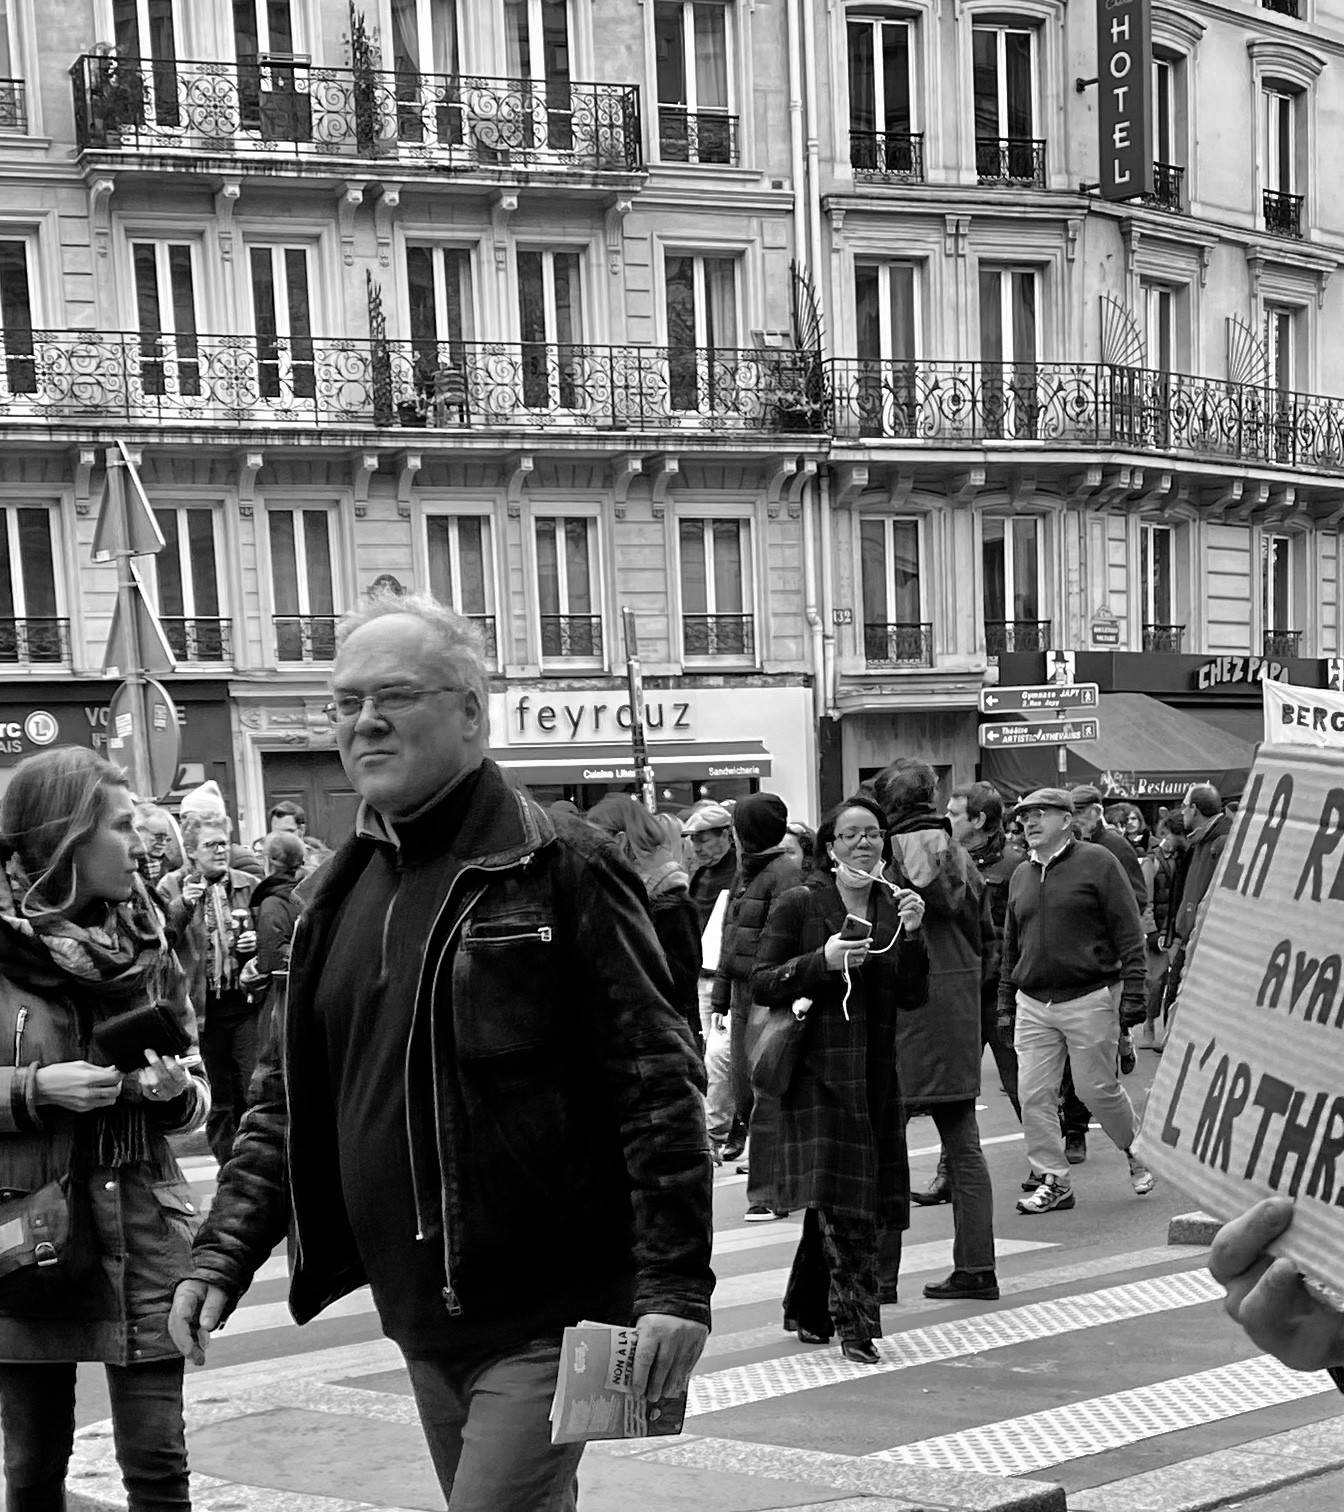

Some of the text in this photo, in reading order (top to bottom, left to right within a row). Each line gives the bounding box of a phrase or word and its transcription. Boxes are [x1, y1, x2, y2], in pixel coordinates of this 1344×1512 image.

[1109, 14, 1132, 185] HOTEL
[833, 610, 852, 622] 132
[1198, 657, 1289, 690] CHEZ PAPA
[1059, 689, 1080, 698] JAPY
[516, 695, 691, 739] feyrouz
[1219, 773, 1294, 898] LA
[618, 1331, 628, 1346] LA
[612, 1359, 625, 1386] NON
